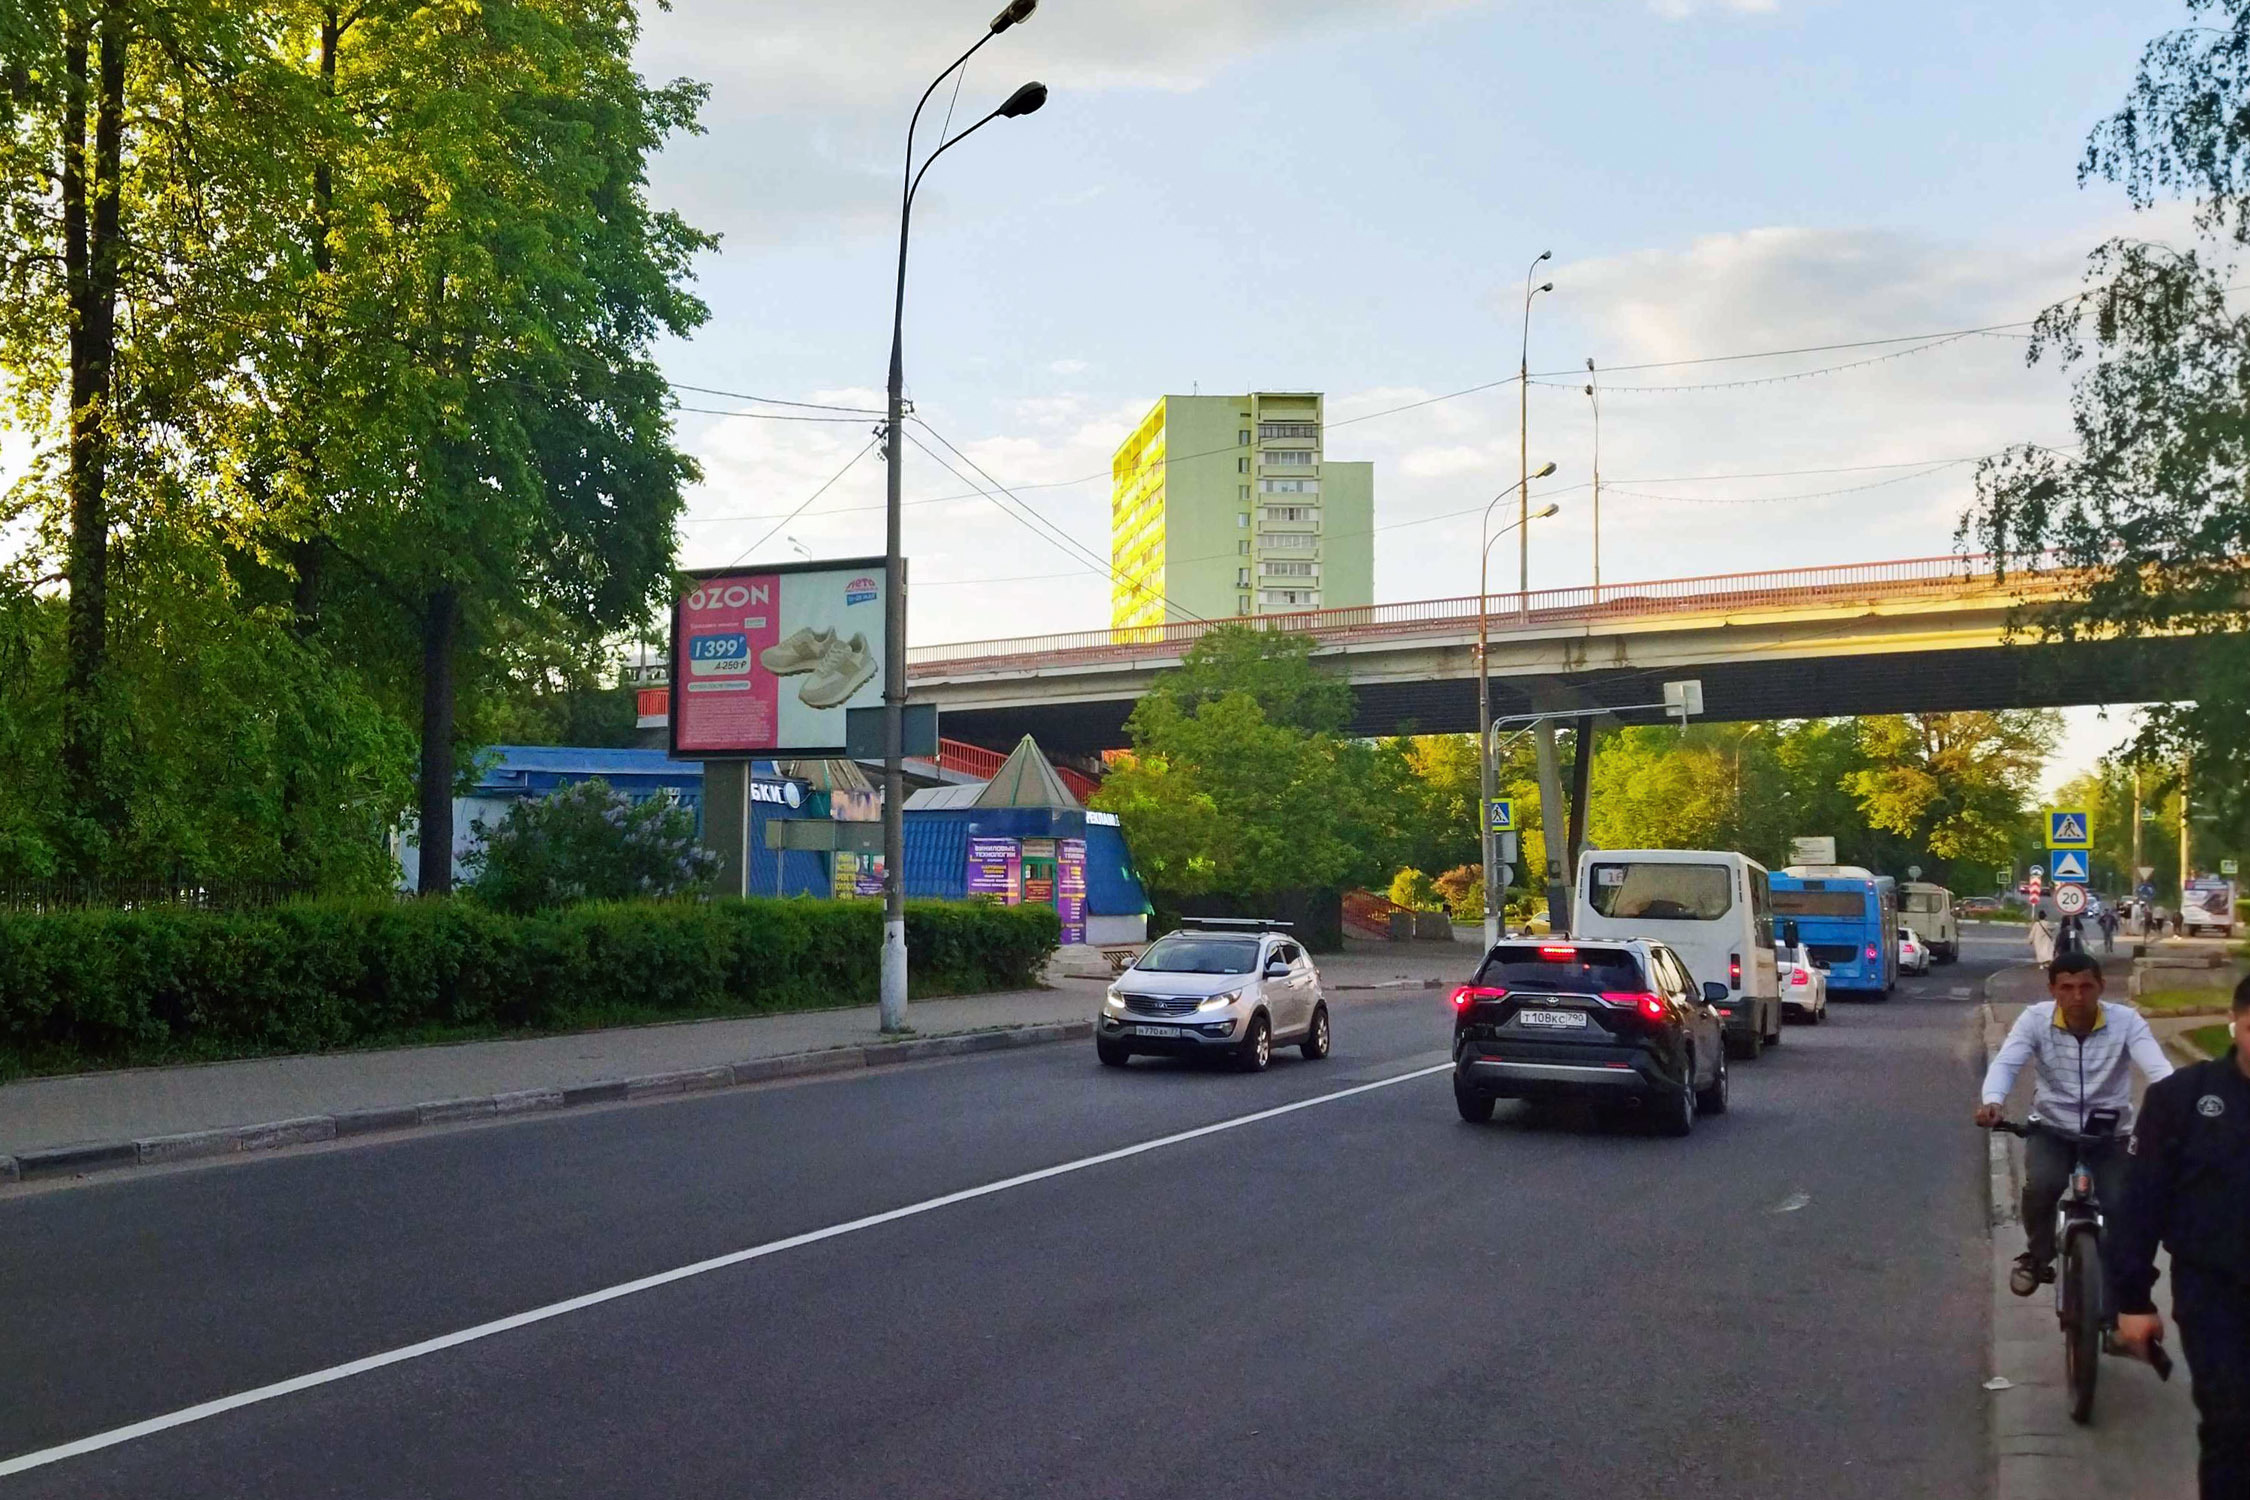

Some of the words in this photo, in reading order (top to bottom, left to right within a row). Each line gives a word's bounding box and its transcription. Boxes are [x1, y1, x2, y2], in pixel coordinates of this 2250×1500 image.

[688, 584, 769, 611] OZON
[2062, 892, 2079, 905] 20
[1524, 1012, 1566, 1024] Т108КС
[1567, 1013, 1584, 1022] 790
